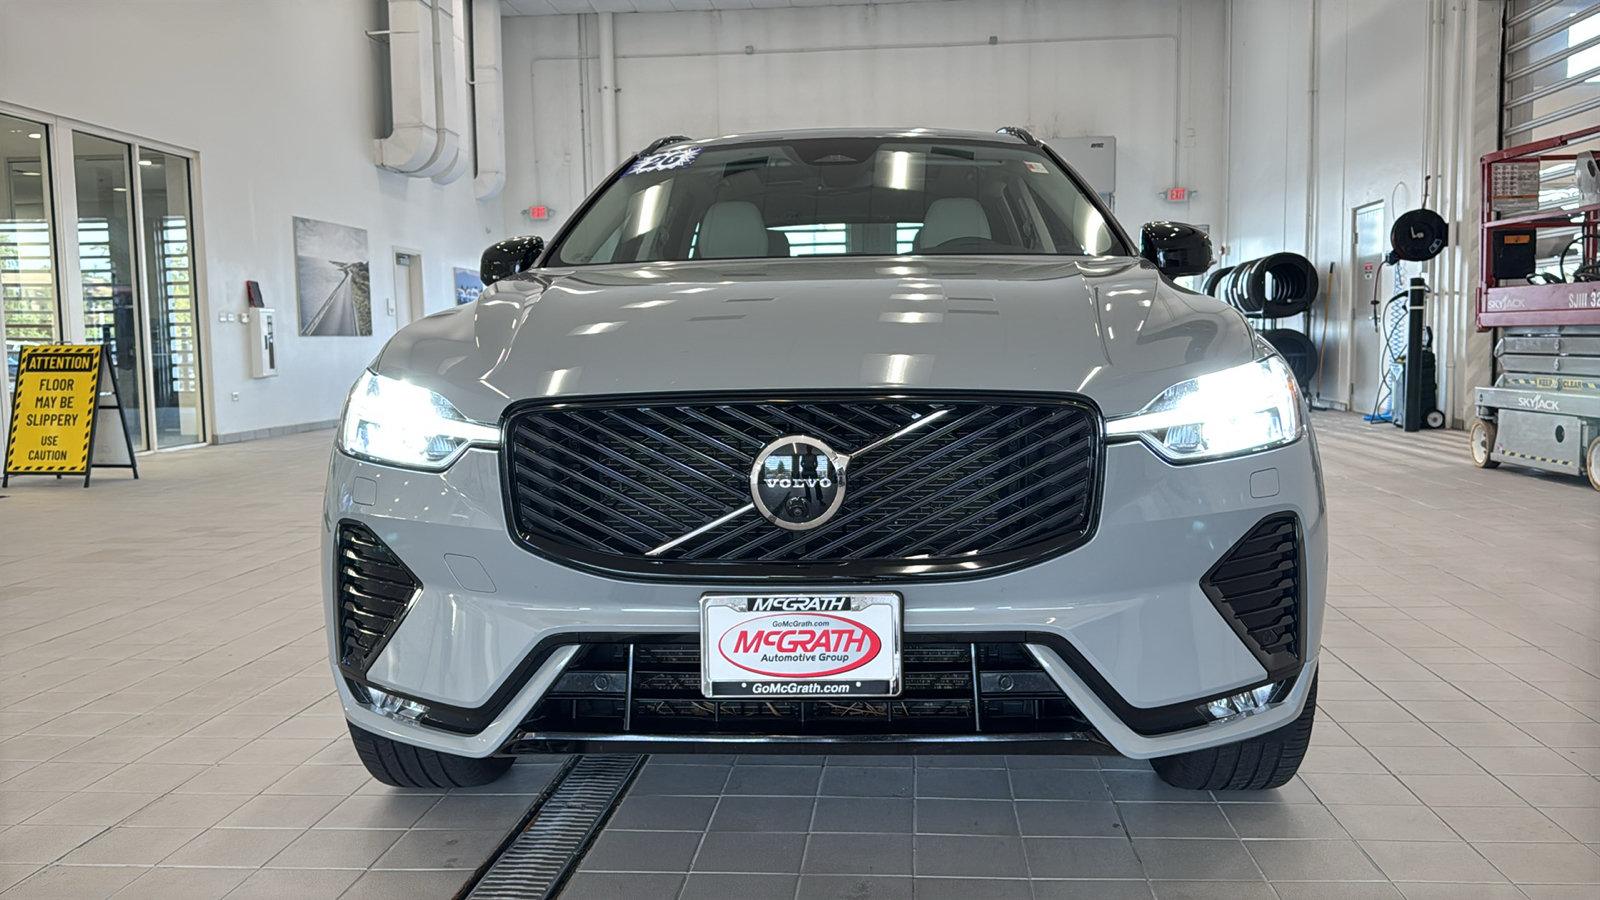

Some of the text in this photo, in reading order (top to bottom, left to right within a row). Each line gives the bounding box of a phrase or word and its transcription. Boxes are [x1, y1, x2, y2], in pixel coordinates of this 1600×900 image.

[1170, 188, 1185, 200] EXIT
[28, 356, 91, 370] ATTENTION
[39, 378, 75, 391] FLOOR
[35, 396, 75, 409] MAY BE
[1518, 394, 1560, 411] SKYJACK
[26, 413, 78, 426] SLIPPERY
[40, 435, 59, 446] USE
[28, 449, 68, 461] CAUTION
[763, 478, 832, 488] VOLVO
[772, 620, 830, 628] GoMcGrath.com
[760, 653, 849, 663] Automotive Group
[752, 682, 850, 694] GoMcGrath.com
